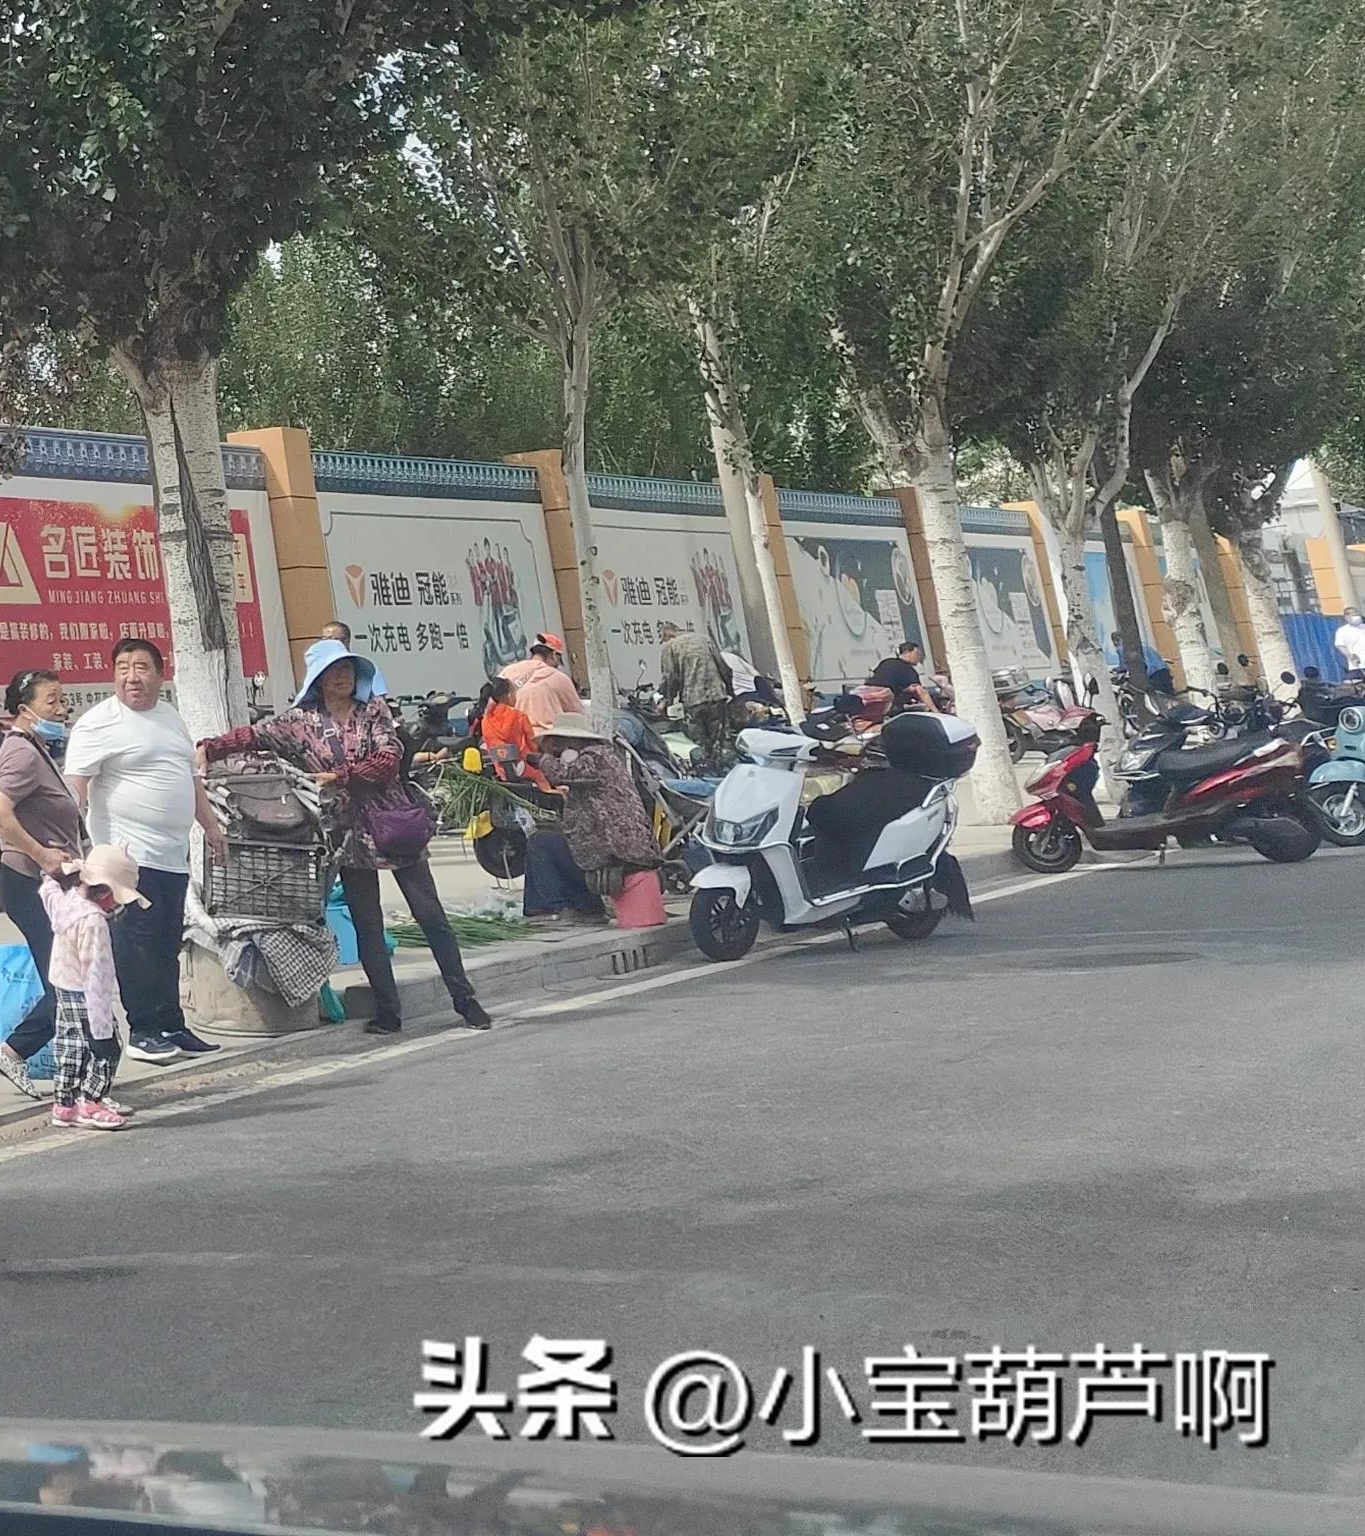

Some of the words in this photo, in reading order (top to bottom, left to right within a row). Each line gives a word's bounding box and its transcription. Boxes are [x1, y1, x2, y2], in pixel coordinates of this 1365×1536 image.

[40, 524, 161, 582] 名匠装饰
[48, 590, 73, 604] MING
[76, 590, 104, 605] JIANG
[107, 590, 147, 605] ZHUANG
[370, 571, 413, 606] 雅迪
[355, 621, 412, 653] 一次充电
[415, 621, 470, 652] 多跑一倍
